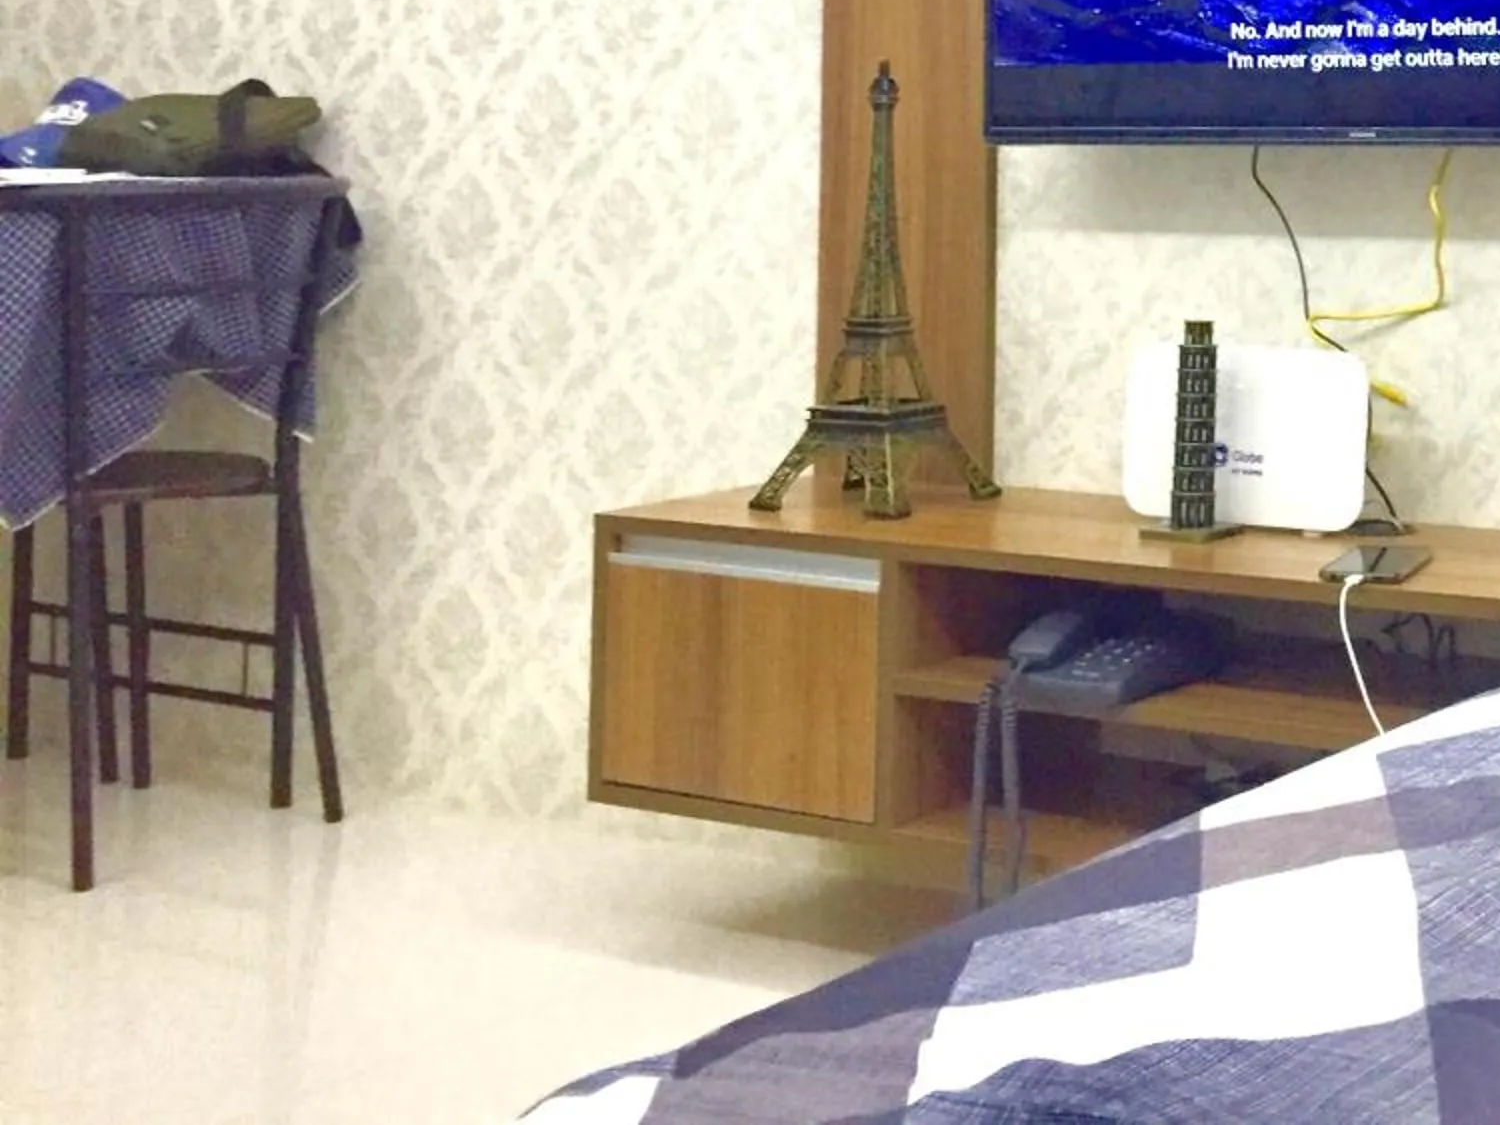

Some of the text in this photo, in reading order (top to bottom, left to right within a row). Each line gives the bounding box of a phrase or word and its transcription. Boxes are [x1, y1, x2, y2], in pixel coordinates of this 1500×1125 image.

[1230, 22, 1261, 40] No.
[1265, 20, 1303, 39] And
[1305, 24, 1344, 38] now
[1347, 19, 1374, 38] I'm
[1377, 22, 1389, 37] a
[1392, 18, 1428, 41] day
[1227, 51, 1254, 69] I'm
[1257, 54, 1307, 68] never
[1310, 53, 1367, 72] gonna
[1370, 48, 1402, 72] get
[1405, 48, 1454, 67] outta
